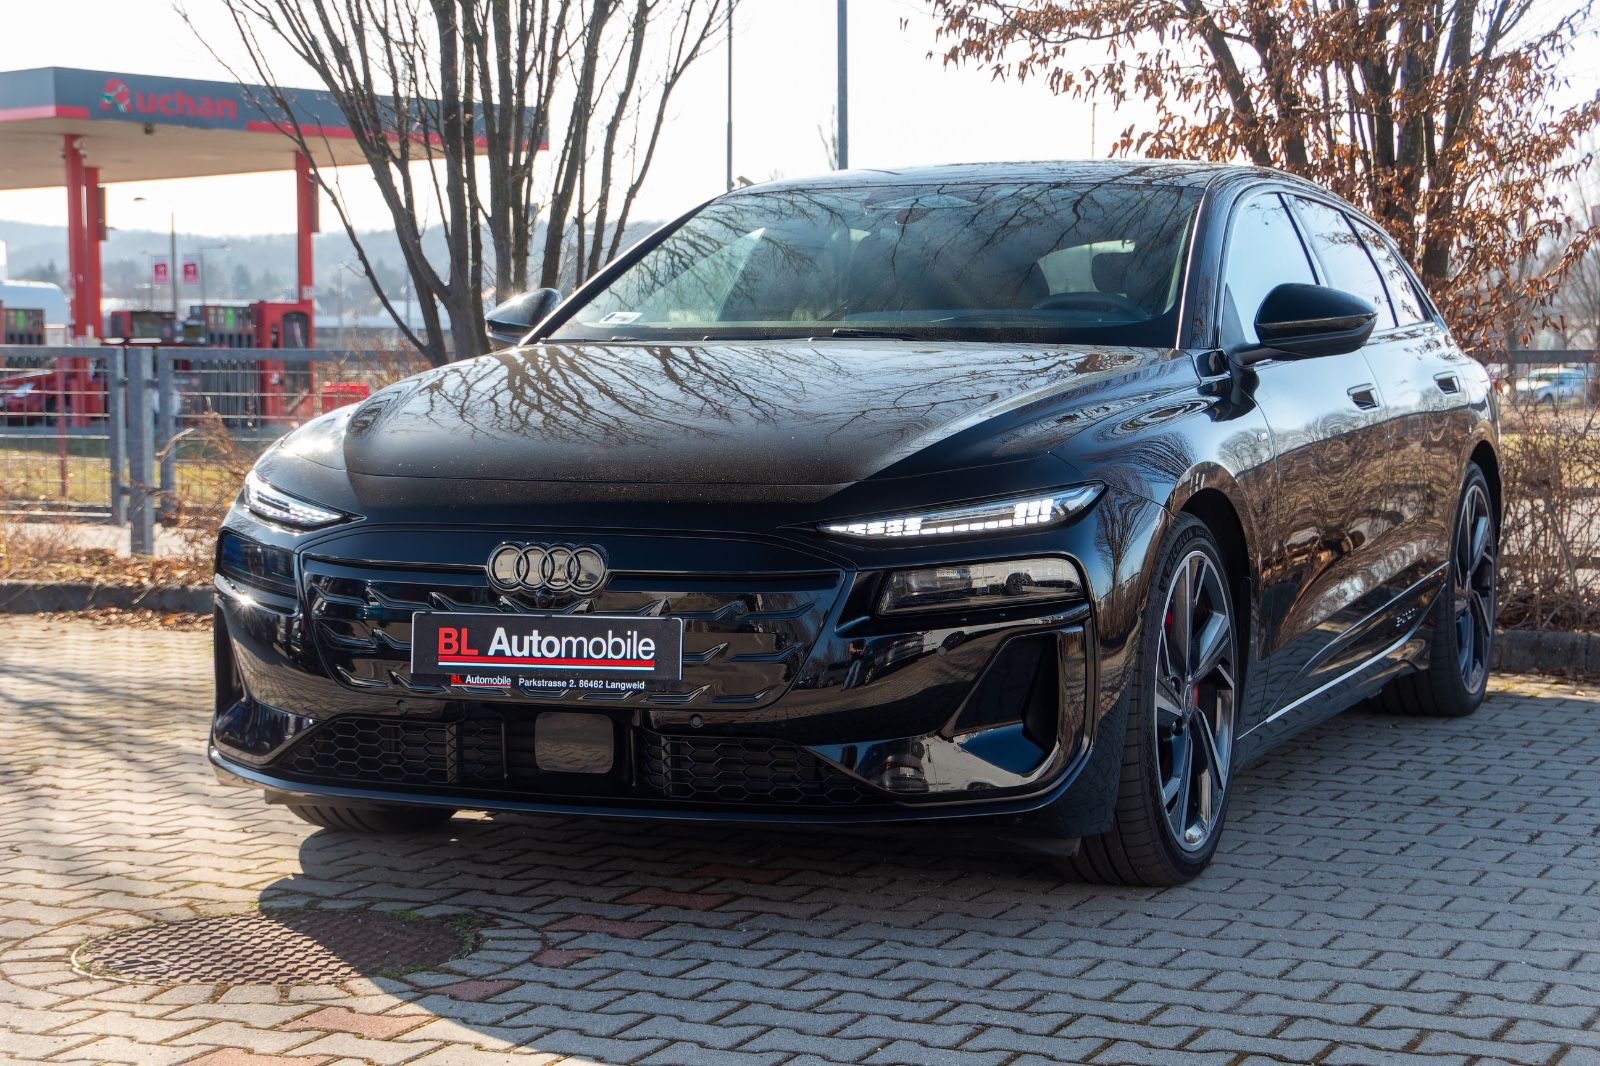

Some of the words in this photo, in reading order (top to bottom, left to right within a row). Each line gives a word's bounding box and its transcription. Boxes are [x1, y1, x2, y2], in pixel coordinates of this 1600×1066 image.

[100, 79, 238, 121] Auchan
[438, 627, 478, 655] BL
[488, 627, 655, 660] Automobile
[450, 674, 464, 684] BL
[465, 674, 511, 685] Automobile
[518, 677, 567, 687] Parkstrasse
[578, 679, 603, 689] 86462
[606, 680, 645, 691] Langweid
